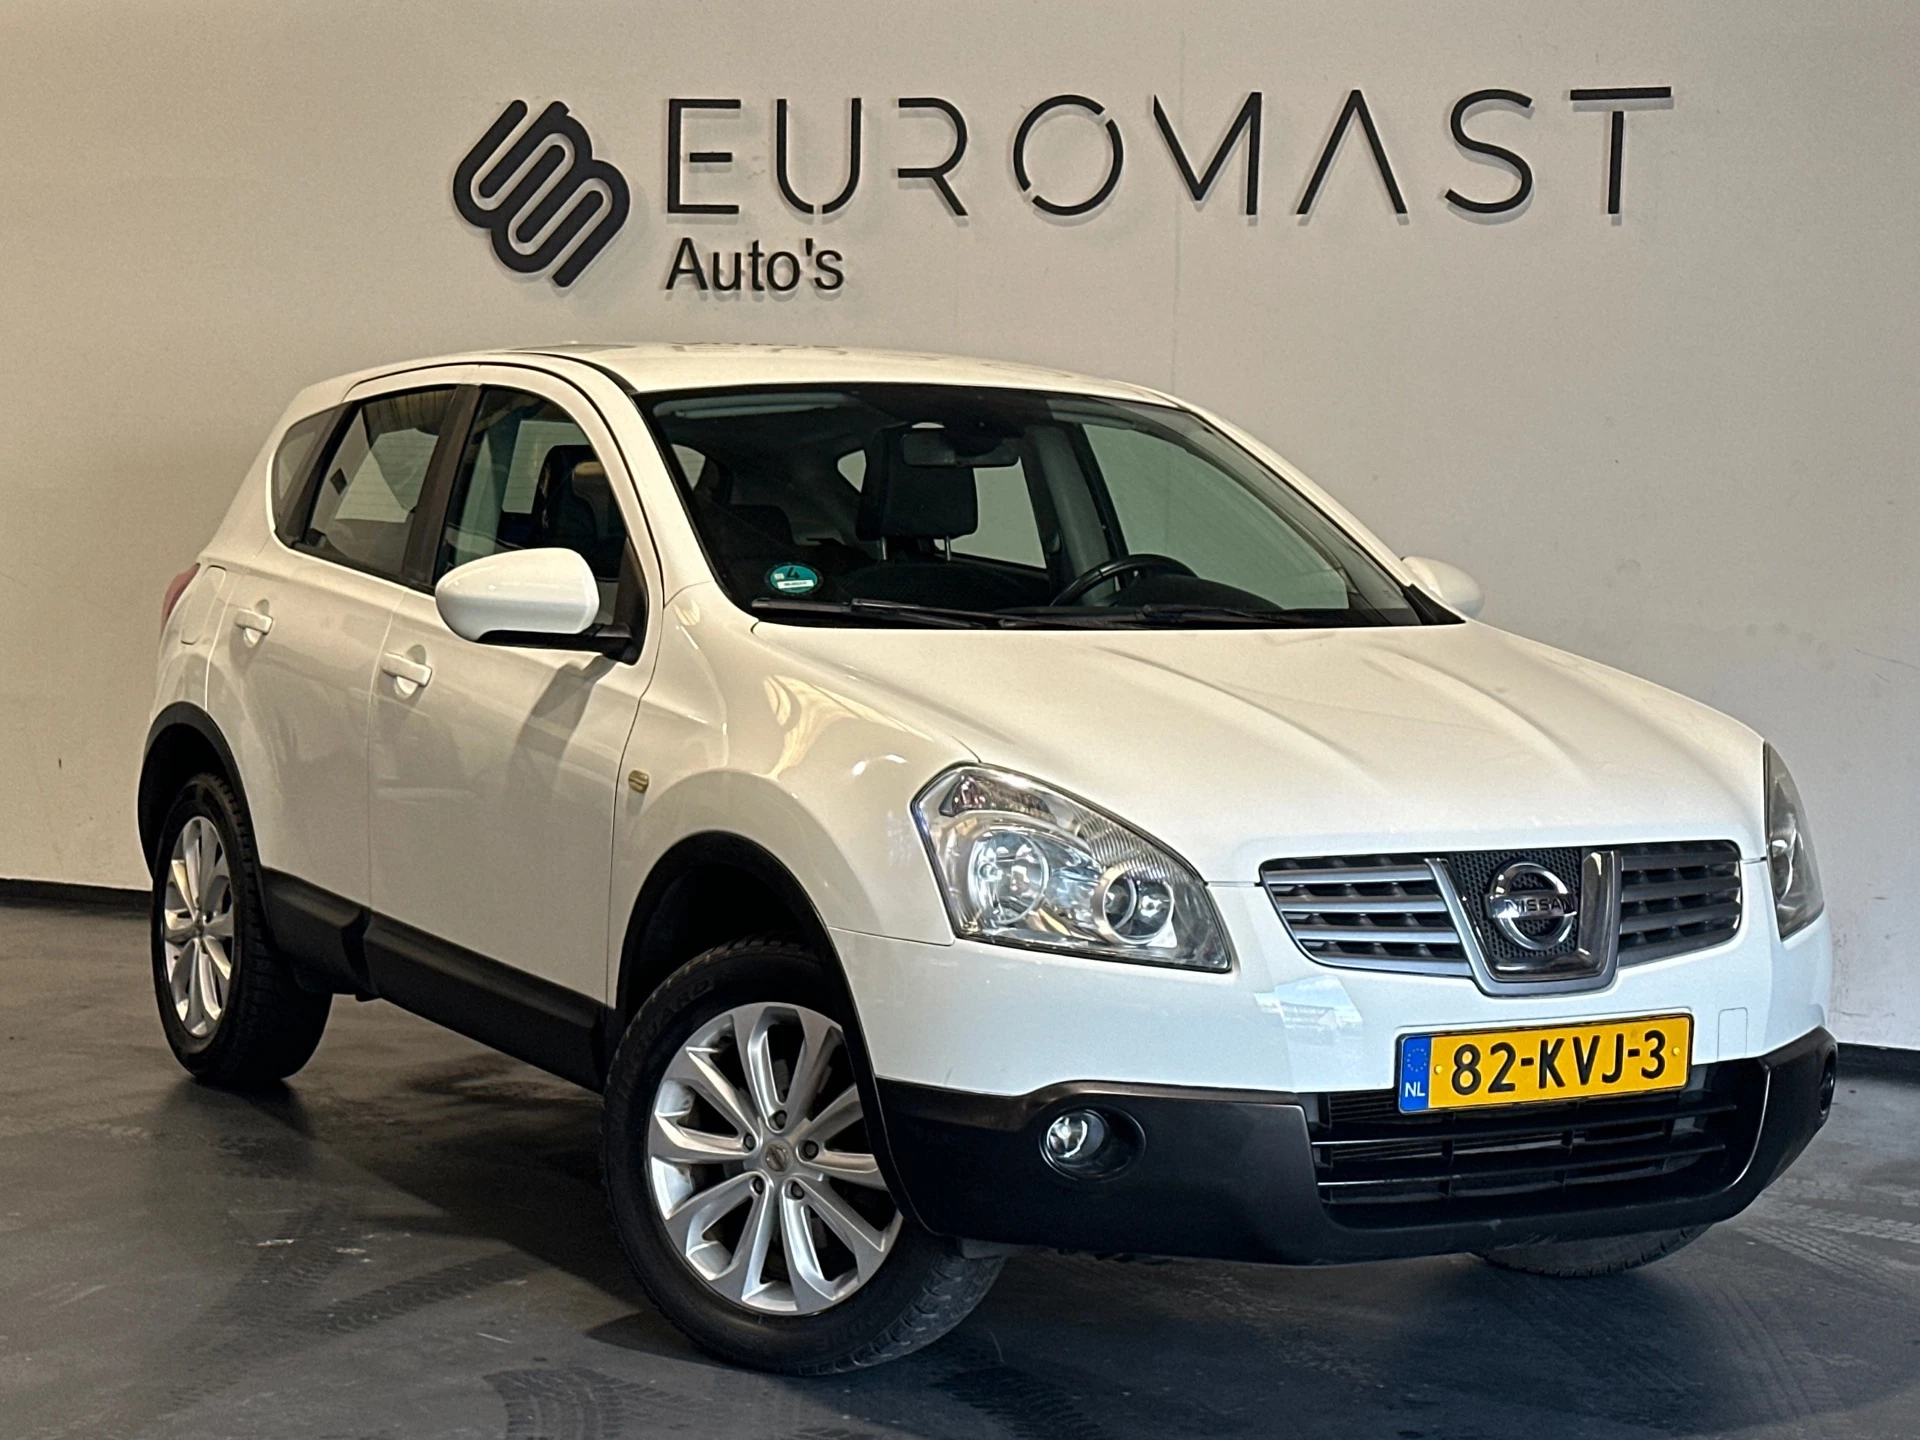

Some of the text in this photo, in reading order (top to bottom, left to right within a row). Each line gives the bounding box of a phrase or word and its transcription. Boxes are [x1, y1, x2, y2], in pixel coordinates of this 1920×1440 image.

[667, 86, 1672, 217] EUROMAST
[665, 237, 845, 291] Auto's
[786, 567, 800, 579] 4
[1504, 897, 1574, 913] NISSAN
[1451, 1029, 1667, 1096] 82-KVJ-3
[1404, 1081, 1426, 1098] NL
